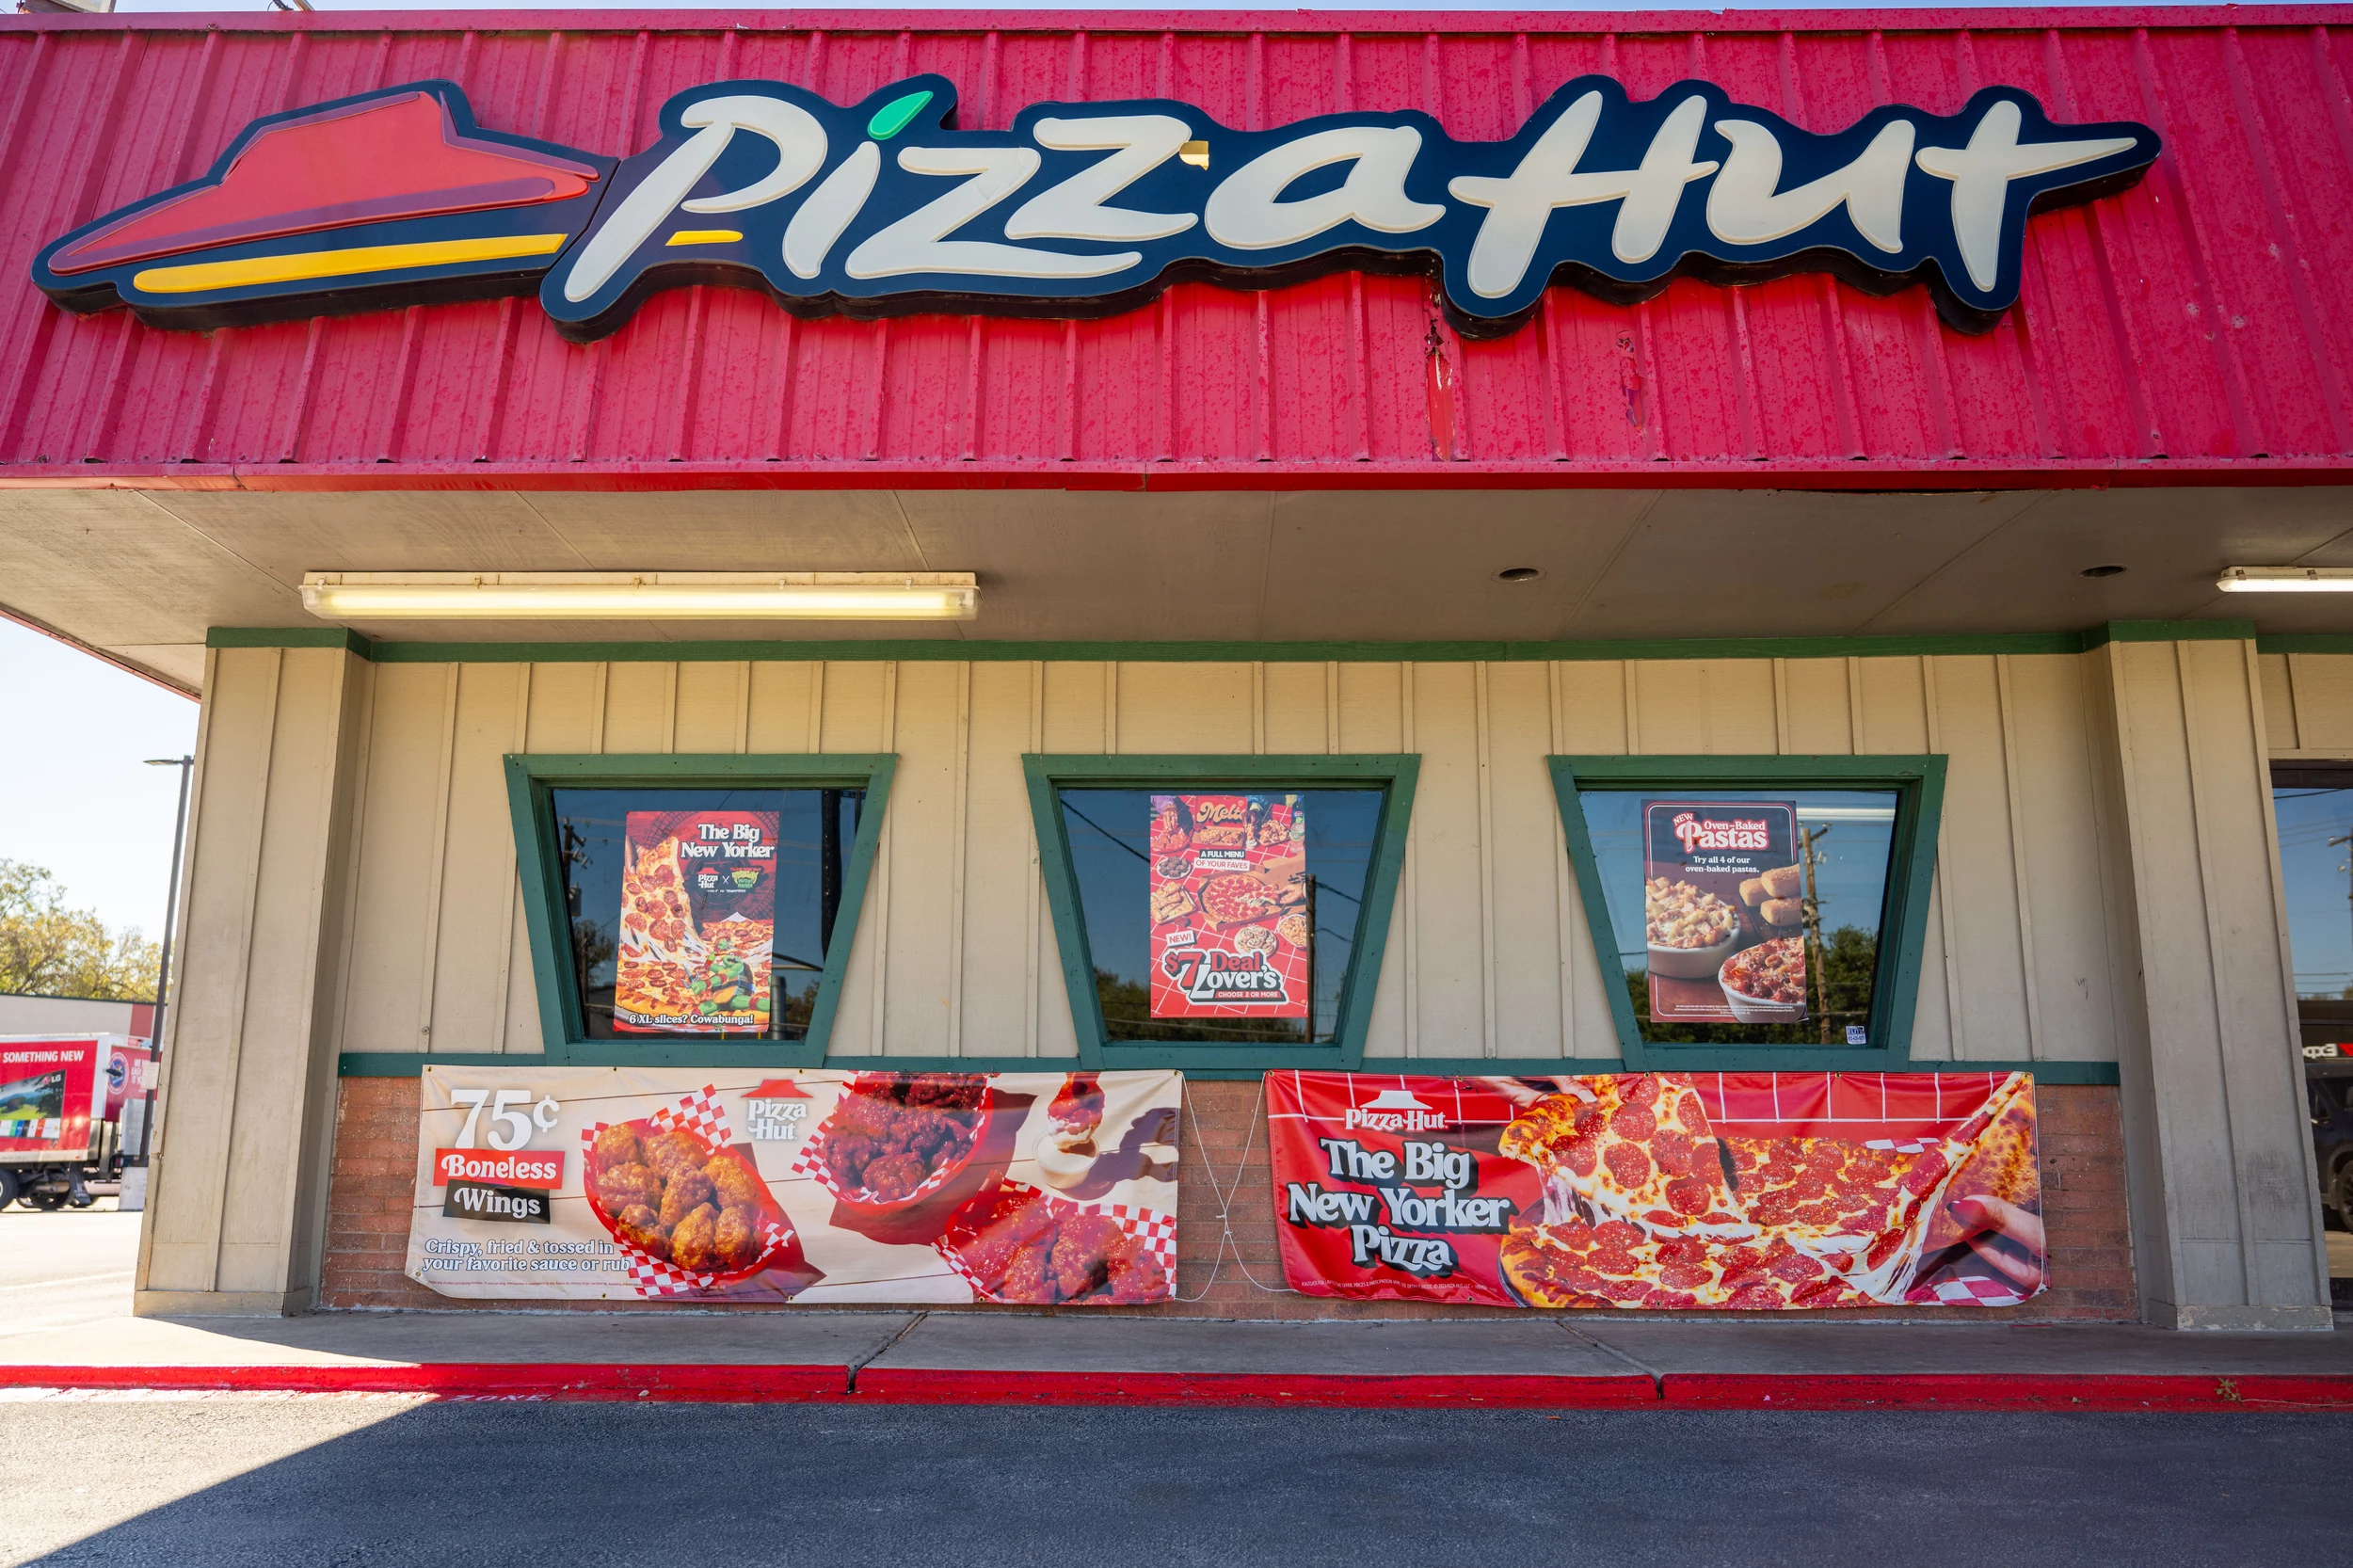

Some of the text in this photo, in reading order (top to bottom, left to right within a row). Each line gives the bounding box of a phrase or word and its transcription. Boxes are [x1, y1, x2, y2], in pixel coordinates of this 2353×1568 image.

[565, 90, 2137, 302] Pizza Hut
[1673, 813, 1693, 825] NEW
[1704, 821, 1766, 830] Oven-Baked
[697, 824, 760, 843] The Big
[1676, 821, 1768, 851] Pastas
[680, 841, 775, 857] New Yorker
[1693, 856, 1706, 864] Try
[697, 873, 718, 883] Pizza
[1169, 933, 1193, 943] NEW!
[1210, 952, 1260, 971] Deal
[1190, 965, 1278, 999] Lover's
[629, 1014, 754, 1025] 6 XL slices? Cowabunga!
[3, 1050, 85, 1064] SOMETHING NEW
[747, 1098, 808, 1121] Pizza
[1345, 1108, 1446, 1130] Pizza Hut
[747, 1118, 796, 1140] Hut
[440, 1154, 556, 1179] Boneless
[1321, 1138, 1470, 1189] The Big
[454, 1187, 541, 1219] Wings
[1288, 1183, 1510, 1227] New Yorker
[424, 1239, 615, 1256] Crispy, fried & tossed in
[1351, 1224, 1452, 1271] Pizza
[423, 1256, 631, 1272] your favorite sauce or rub
